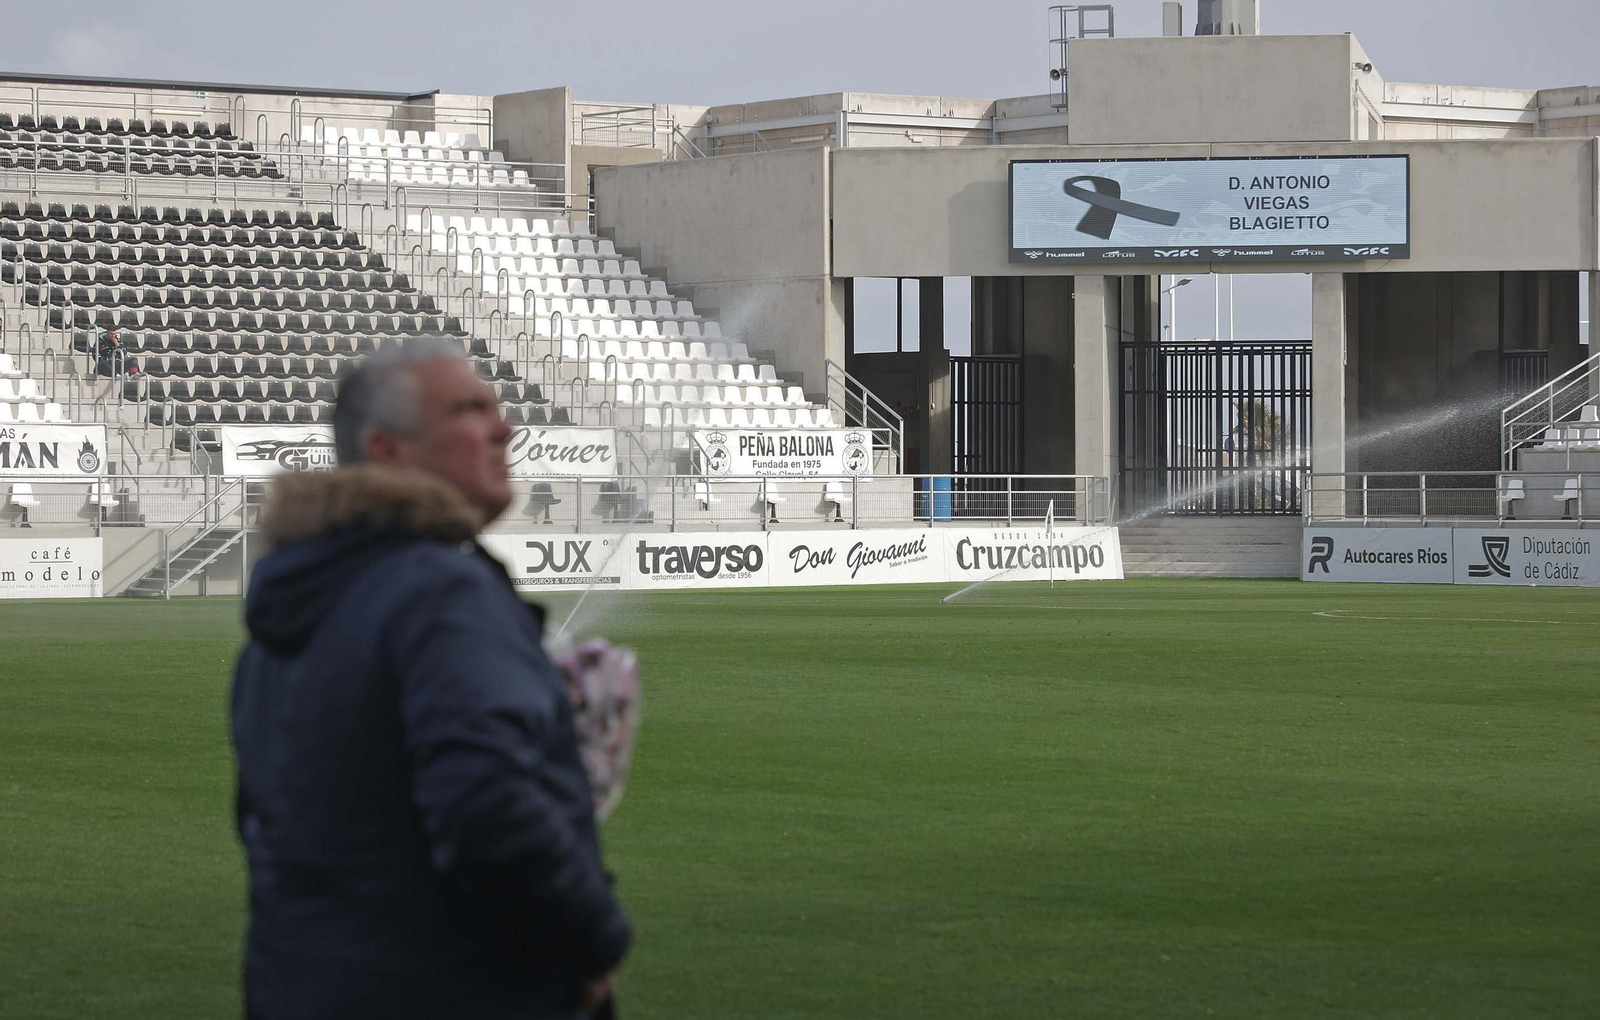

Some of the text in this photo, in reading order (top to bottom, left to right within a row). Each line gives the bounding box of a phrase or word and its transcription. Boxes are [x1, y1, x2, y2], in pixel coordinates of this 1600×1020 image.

[1228, 175, 1330, 190] D. ANTONIO
[1244, 195, 1310, 210] VIEGAS
[1229, 215, 1330, 231] BLAGIETTO
[504, 427, 613, 469] Córner
[739, 433, 835, 457] PEÑA BALONA
[752, 459, 822, 469] Fundada en 1975
[994, 532, 1027, 540] DESDE
[30, 547, 71, 560] café
[1523, 536, 1591, 557] Diputación
[525, 540, 593, 573] DUX
[636, 540, 764, 579] traverso
[789, 533, 927, 579] Don Giovanni
[956, 536, 1104, 574] Cruzcampo
[1343, 547, 1448, 564] Autocares Ríos
[1, 566, 101, 581] modelo
[717, 572, 737, 580] desde
[1524, 561, 1579, 580] de Cádiz
[561, 577, 613, 585] TRANSFERENCIAS
